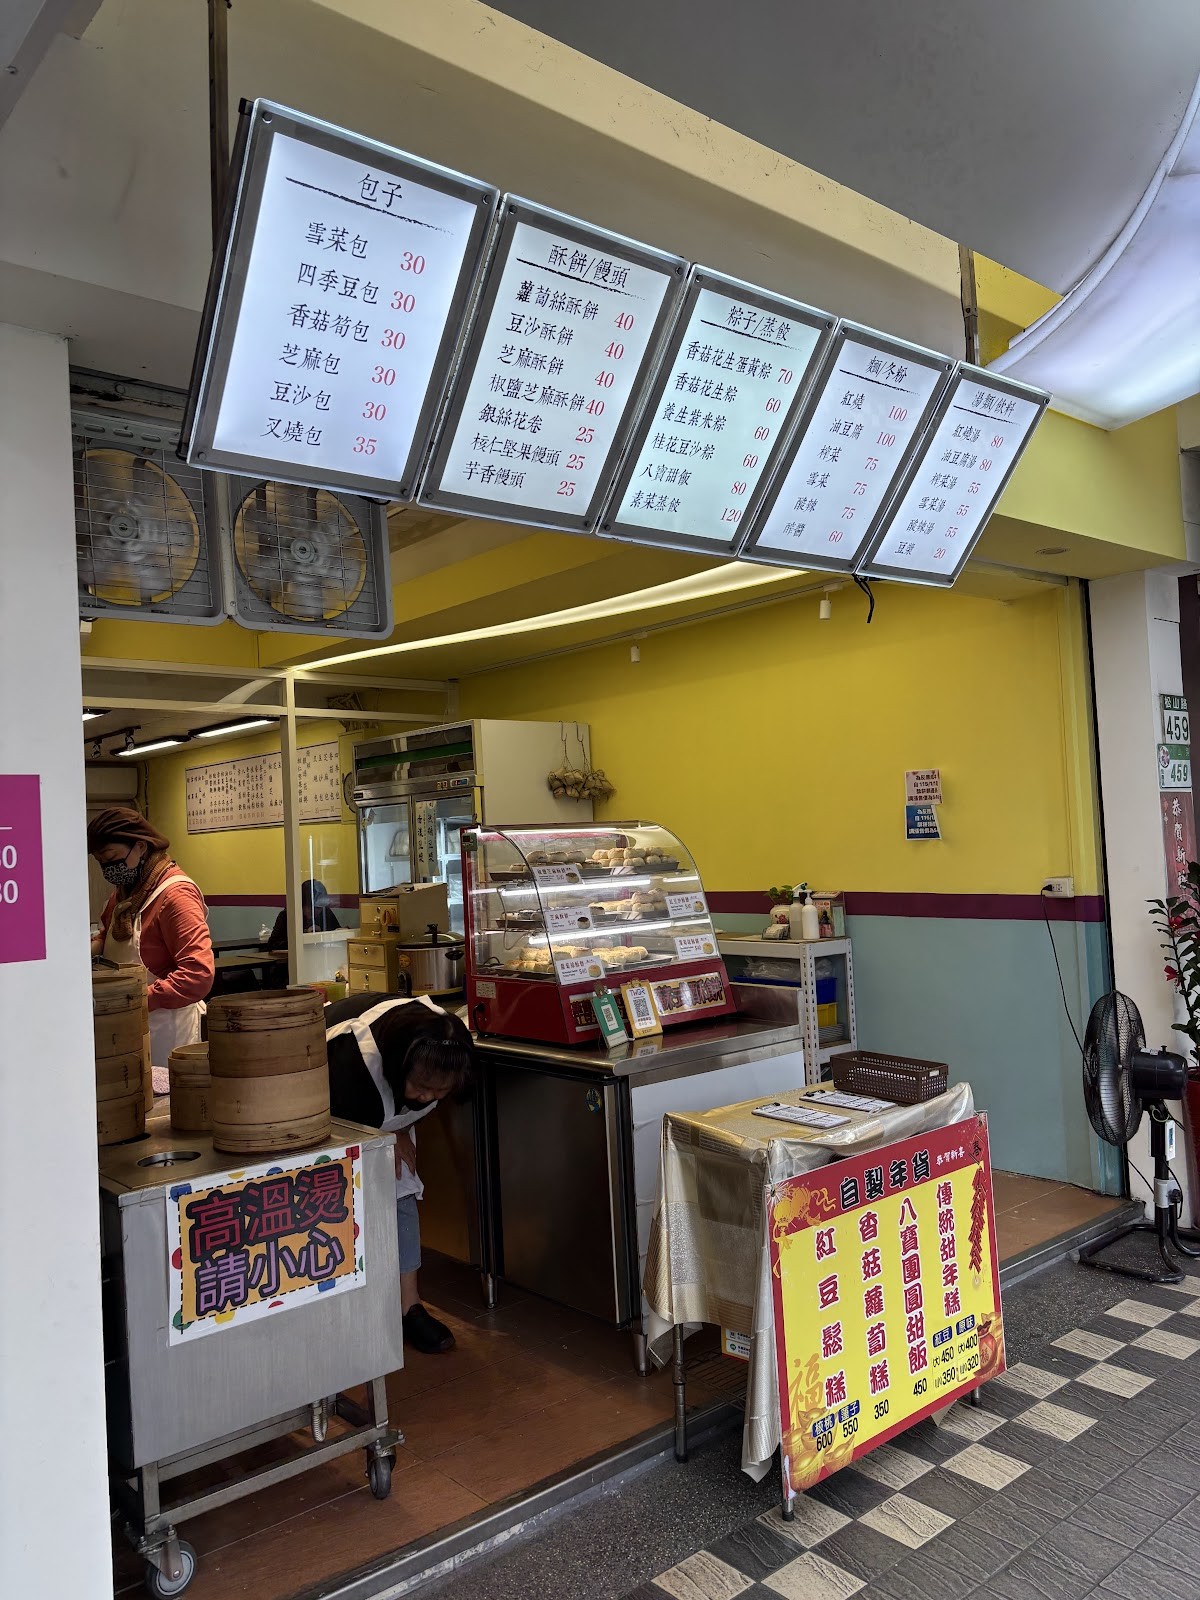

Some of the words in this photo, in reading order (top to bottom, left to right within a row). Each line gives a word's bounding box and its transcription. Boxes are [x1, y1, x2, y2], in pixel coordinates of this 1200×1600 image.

[358, 173, 402, 208] 包子
[305, 222, 368, 260] 雪菜包
[400, 251, 426, 275] 30
[547, 244, 631, 288] 酥餅/饅頭
[297, 262, 379, 305] 四季豆包
[390, 290, 416, 313] 30
[515, 281, 600, 321] 蘿蔔絲酥餅
[614, 312, 635, 331] 40
[286, 304, 369, 343] 香菇筍包
[381, 329, 406, 350] 30
[505, 312, 574, 346] 豆沙酥餅
[604, 341, 624, 360] 40
[725, 305, 792, 342] 粽子/蒸餃
[278, 342, 340, 376] 芝麻包
[371, 365, 396, 386] 30
[497, 343, 565, 376] 芝麻酥餅
[595, 370, 615, 389] 40
[685, 341, 773, 379] 香菇花生蛋黃粽
[777, 368, 793, 384] 70
[269, 380, 331, 412] 豆沙包
[362, 401, 387, 422] 30
[488, 373, 585, 412] 椒鹽芝麻酥餅
[585, 399, 605, 416] 40
[674, 372, 738, 403] 香菇花生粽
[765, 397, 782, 413] 60
[840, 390, 866, 411] 紅燒
[888, 405, 908, 422] 100
[260, 416, 323, 447] 叉燒包
[353, 436, 377, 456] 35
[575, 426, 595, 443] 25
[663, 401, 727, 432] 養生紫米粽
[754, 426, 770, 441] 60
[828, 417, 865, 440] 油豆腐
[876, 431, 896, 447] 100
[471, 432, 562, 467] 核仁堅果饅頭
[566, 454, 586, 471] 25
[652, 432, 716, 460] 桂花豆沙粽
[742, 454, 759, 469] 60
[990, 435, 1004, 449] 80
[462, 460, 527, 489] 芋香饅頭
[556, 481, 576, 497] 25
[806, 471, 831, 489] 雪菜
[852, 482, 868, 496] 75
[864, 457, 880, 472] 75
[979, 459, 993, 471] 80
[730, 481, 747, 496] 80
[967, 482, 982, 494] 55
[719, 507, 743, 522] 120
[793, 496, 819, 513] 酸辣
[840, 506, 856, 520] 75
[956, 504, 970, 516] 55
[828, 530, 843, 543] 60
[944, 526, 959, 538] 55
[932, 548, 946, 560] 20
[1164, 696, 1188, 710] 松山路
[1166, 716, 1189, 741] 459
[1170, 763, 1188, 782] 459
[840, 1149, 931, 1210] 自製年貨
[187, 1165, 347, 1260] 高溫燙
[936, 1181, 962, 1319] 傳統甜年糕
[197, 1230, 344, 1314] 請小心
[899, 1196, 928, 1375] 八寶團圓甜飯
[815, 1226, 848, 1408] 紅豆鬆糕
[858, 1211, 891, 1395] 香菇蘿蔔糕
[934, 1330, 950, 1346] 紅豆
[959, 1316, 975, 1333] 原味
[816, 1431, 833, 1452] 600
[842, 1417, 858, 1438] 550
[874, 1399, 889, 1420] 350
[912, 1377, 928, 1397] 450
